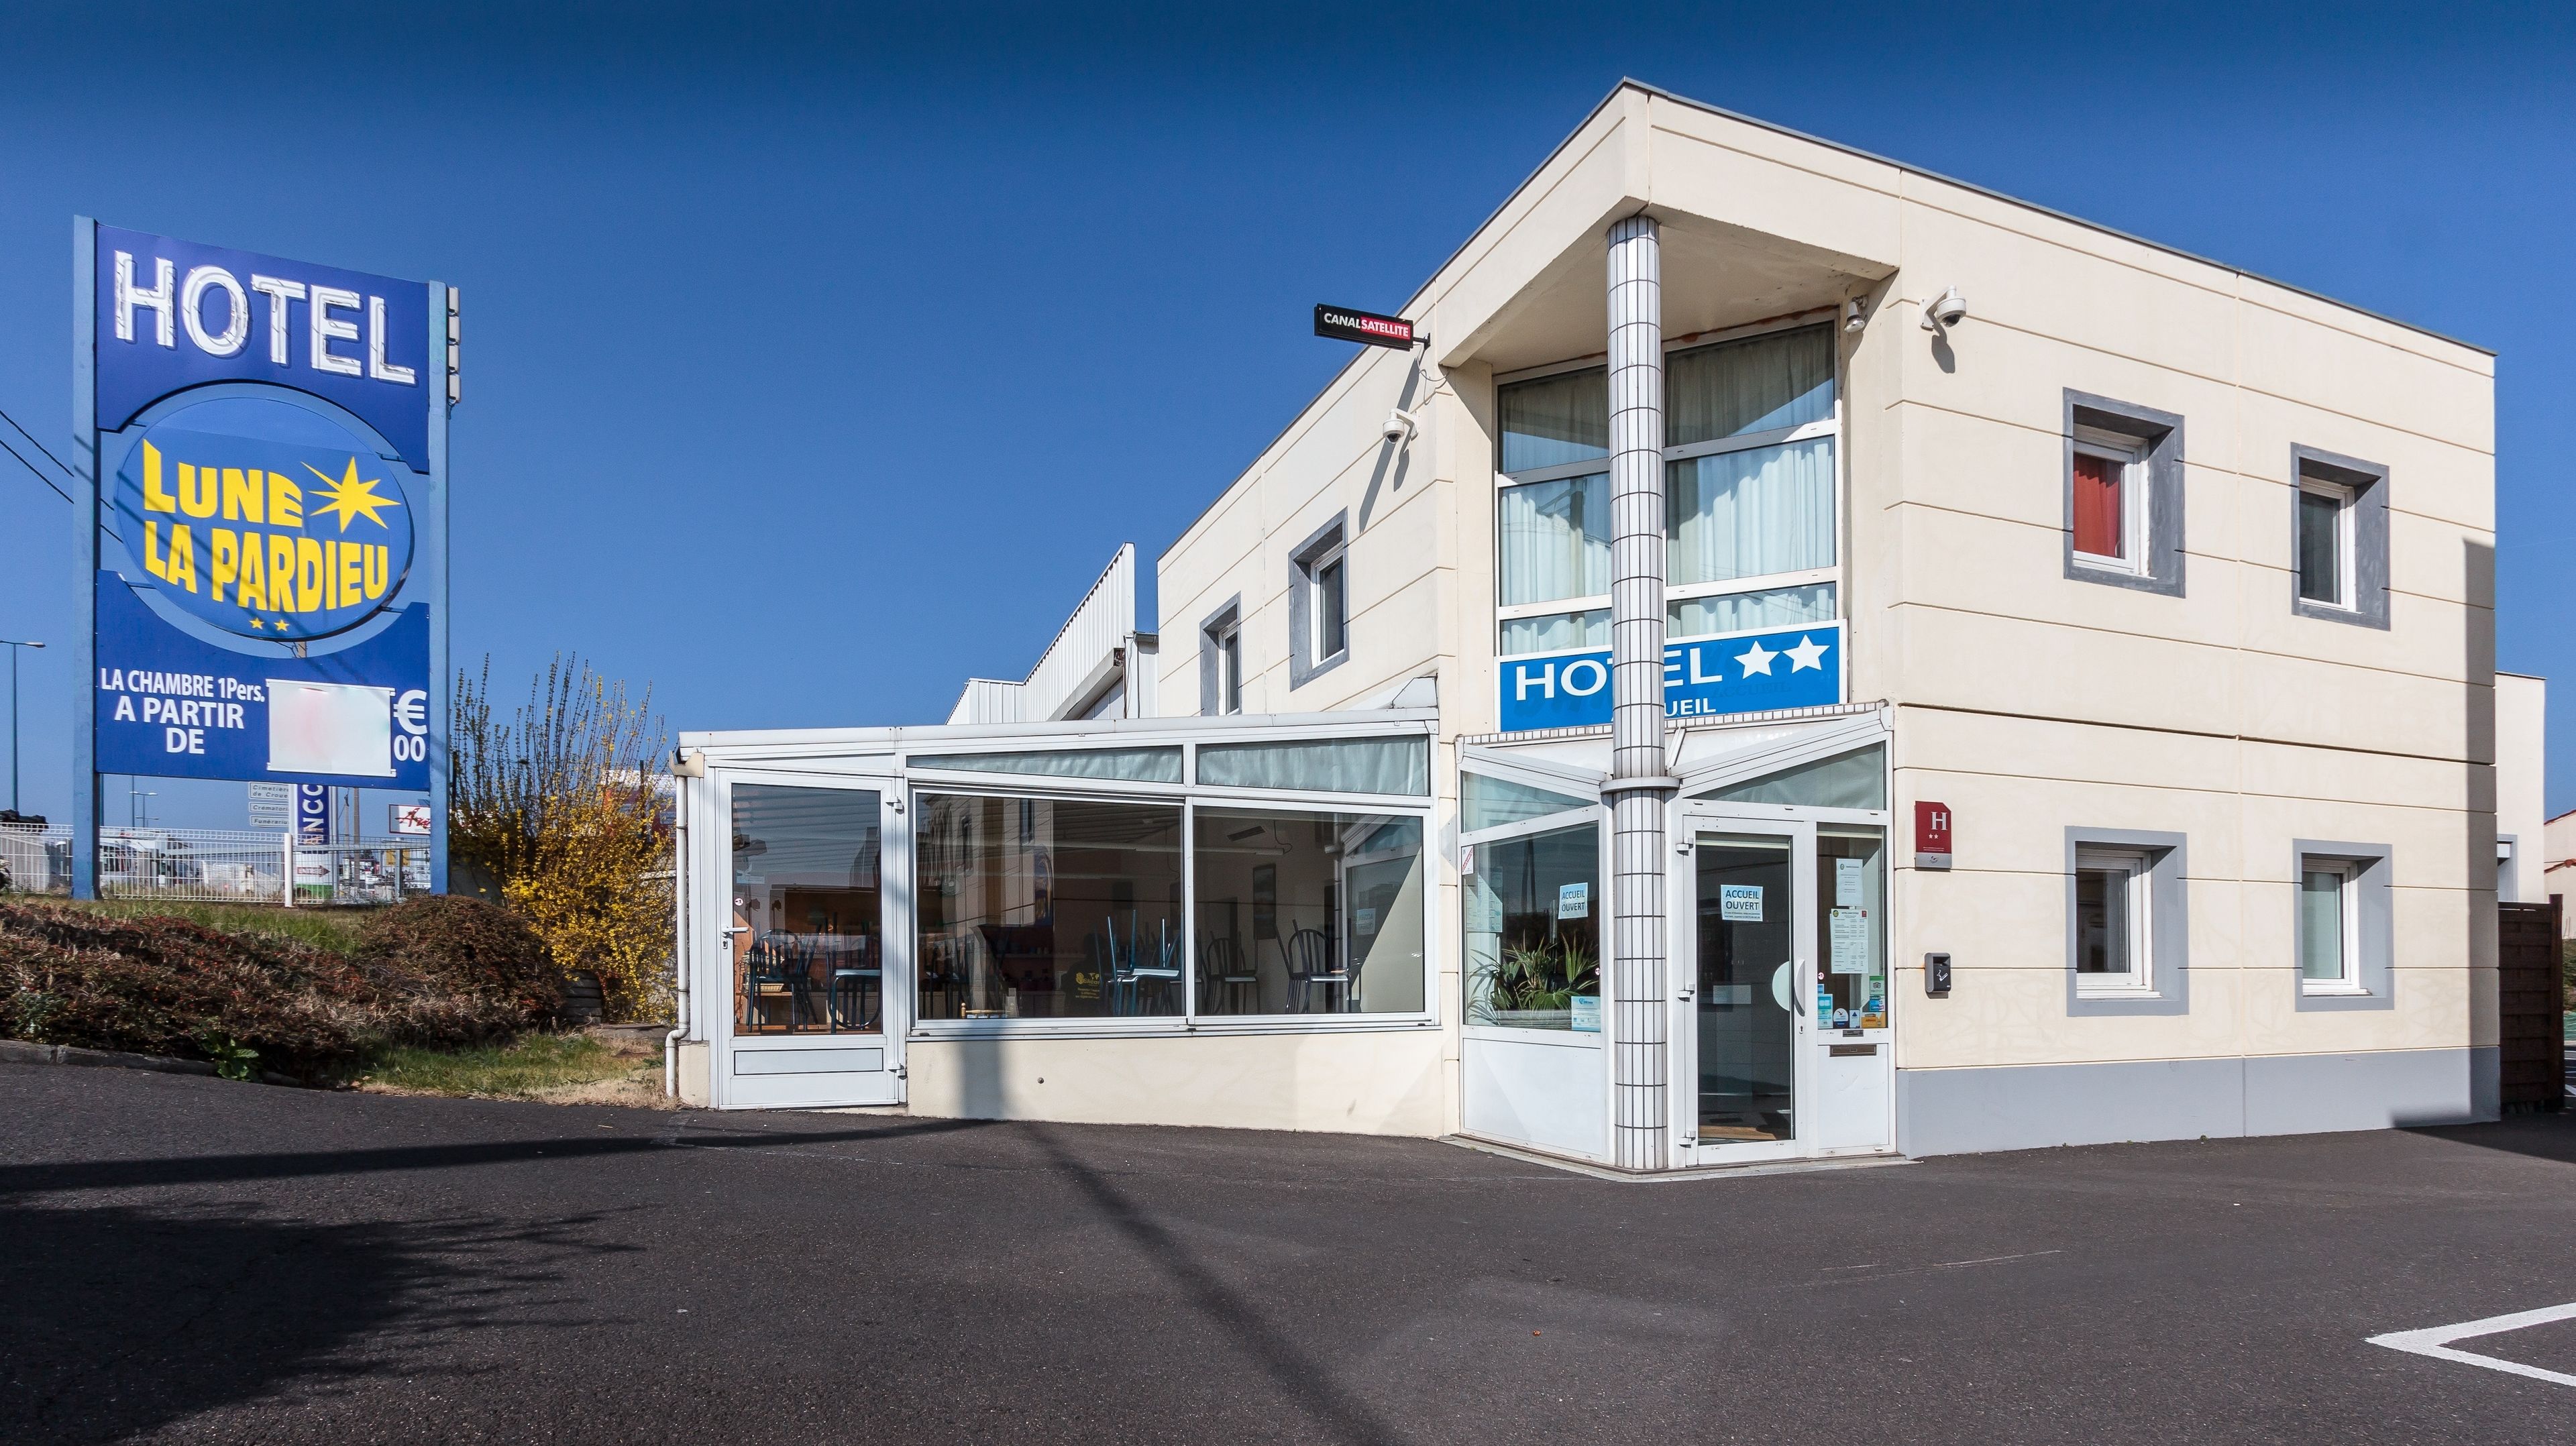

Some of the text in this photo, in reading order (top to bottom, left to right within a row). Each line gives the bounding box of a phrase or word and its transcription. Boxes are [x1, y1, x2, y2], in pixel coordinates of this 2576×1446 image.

[115, 250, 415, 384] HOTEL
[143, 439, 303, 527] LUNE
[144, 521, 388, 612] LA PARDIEU
[101, 668, 265, 702] LA CHAMBRE 1Pers.
[1517, 648, 1723, 701] HOEL
[114, 696, 244, 729] A PARTIR
[393, 689, 427, 734] €
[166, 728, 205, 755] DE
[394, 734, 426, 762] 00
[1931, 812, 1947, 830] H
[1562, 890, 1585, 899] ACCUEIL
[1562, 902, 1585, 911] OUVERT
[1725, 890, 1759, 899] ACCUEIL
[1726, 901, 1759, 910] OUVERT
